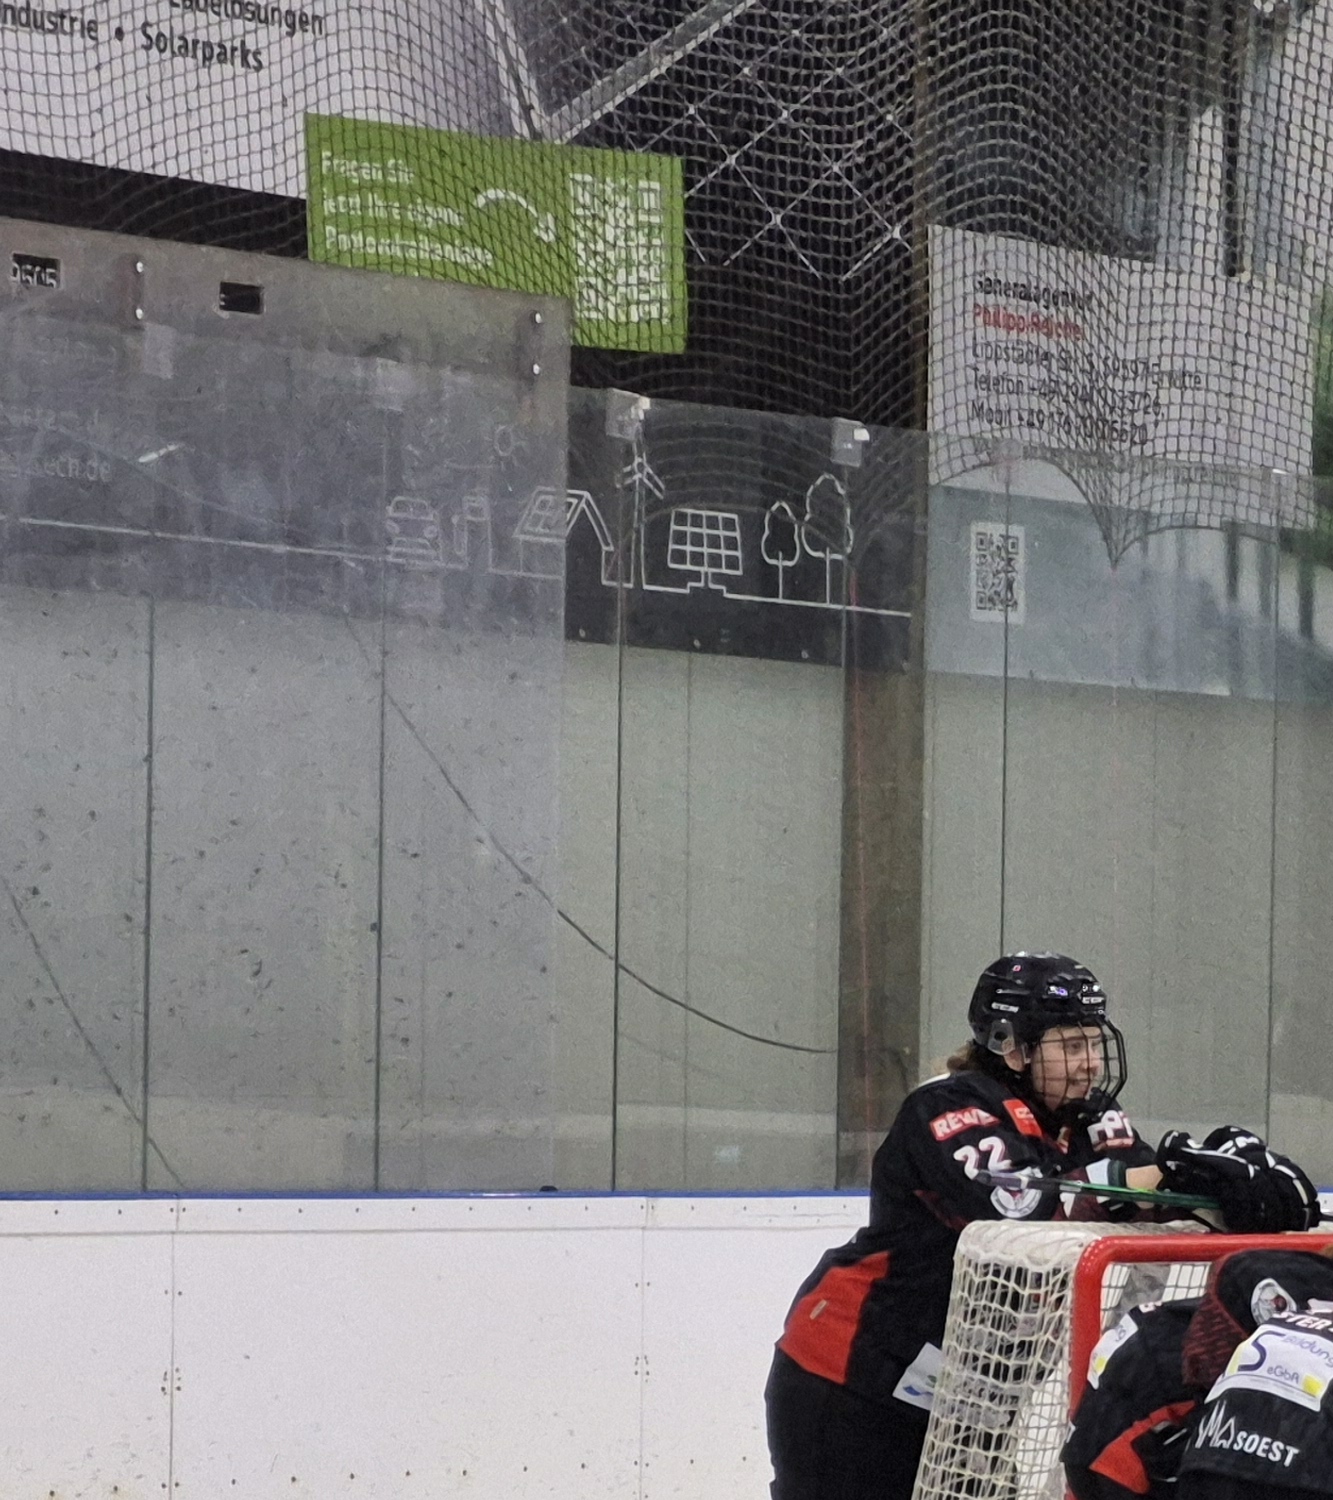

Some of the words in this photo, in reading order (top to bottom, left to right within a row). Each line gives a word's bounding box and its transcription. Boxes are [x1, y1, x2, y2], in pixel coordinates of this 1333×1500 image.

[0, 3, 98, 40] ndustrie
[141, 22, 263, 73] Solarparks
[1232, 1431, 1300, 1467] SOEST
